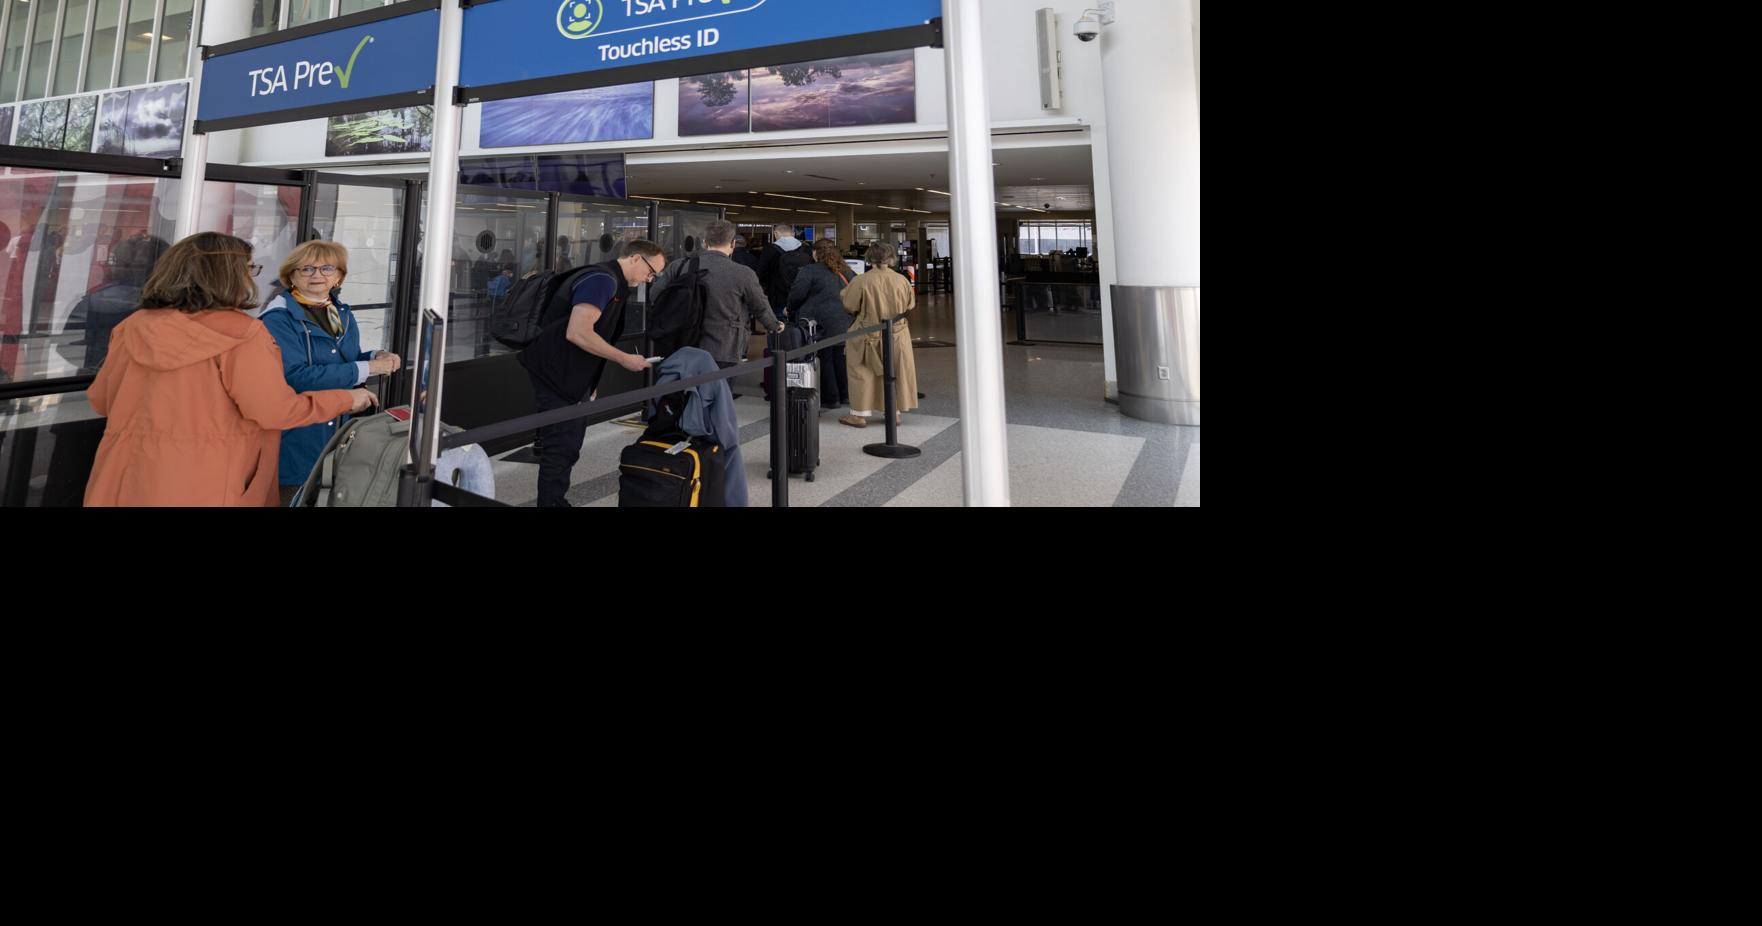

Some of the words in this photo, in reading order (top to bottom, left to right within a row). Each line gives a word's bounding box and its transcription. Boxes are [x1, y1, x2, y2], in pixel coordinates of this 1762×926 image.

[621, 0, 667, 17] TSA
[598, 34, 691, 62] Touchless
[696, 28, 720, 48] ID
[248, 65, 288, 97] TSA
[293, 60, 333, 90] Pre
